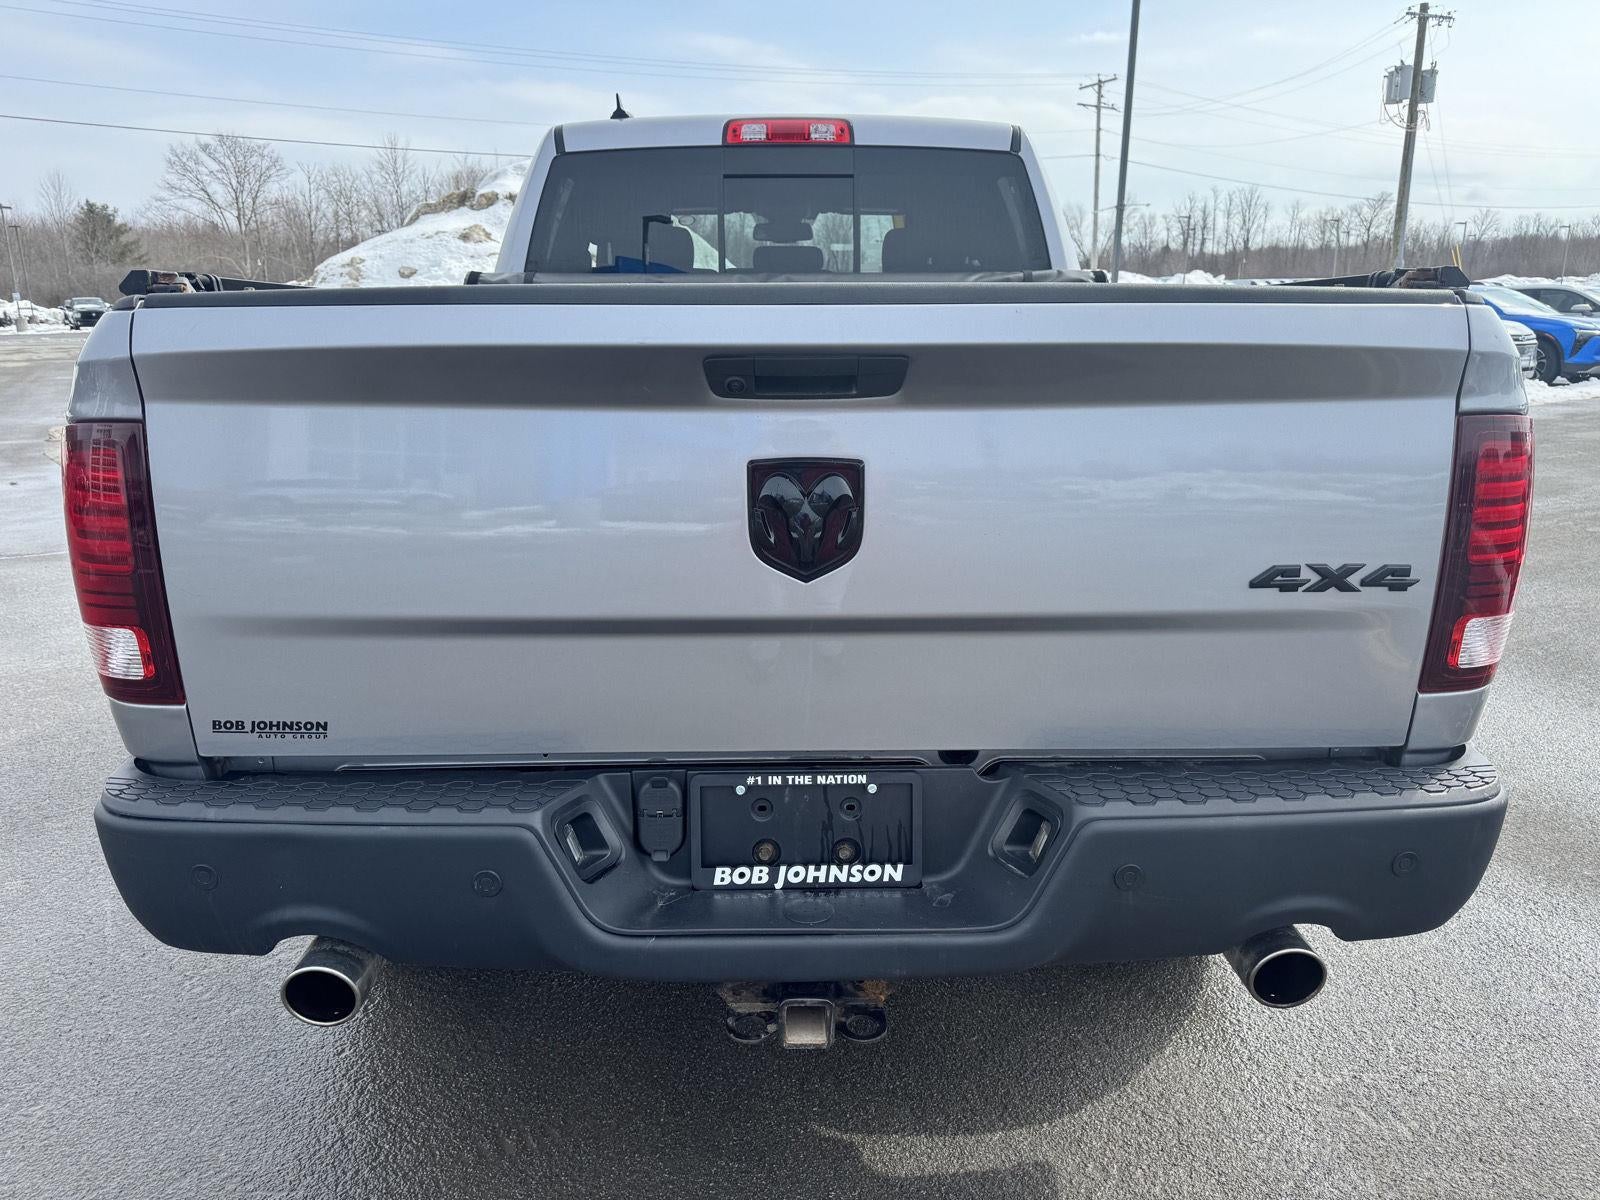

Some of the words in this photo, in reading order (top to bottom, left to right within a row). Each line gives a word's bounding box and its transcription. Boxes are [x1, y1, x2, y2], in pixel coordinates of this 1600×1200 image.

[1249, 563, 1421, 592] 4X4
[212, 720, 245, 731] BOB
[250, 720, 328, 734] JOHNSON
[746, 775, 762, 785] #1
[768, 775, 782, 785] IN
[786, 775, 812, 785] THE
[817, 774, 867, 785] NATION
[713, 866, 769, 886] BOB
[774, 863, 904, 890] JOHNSON
